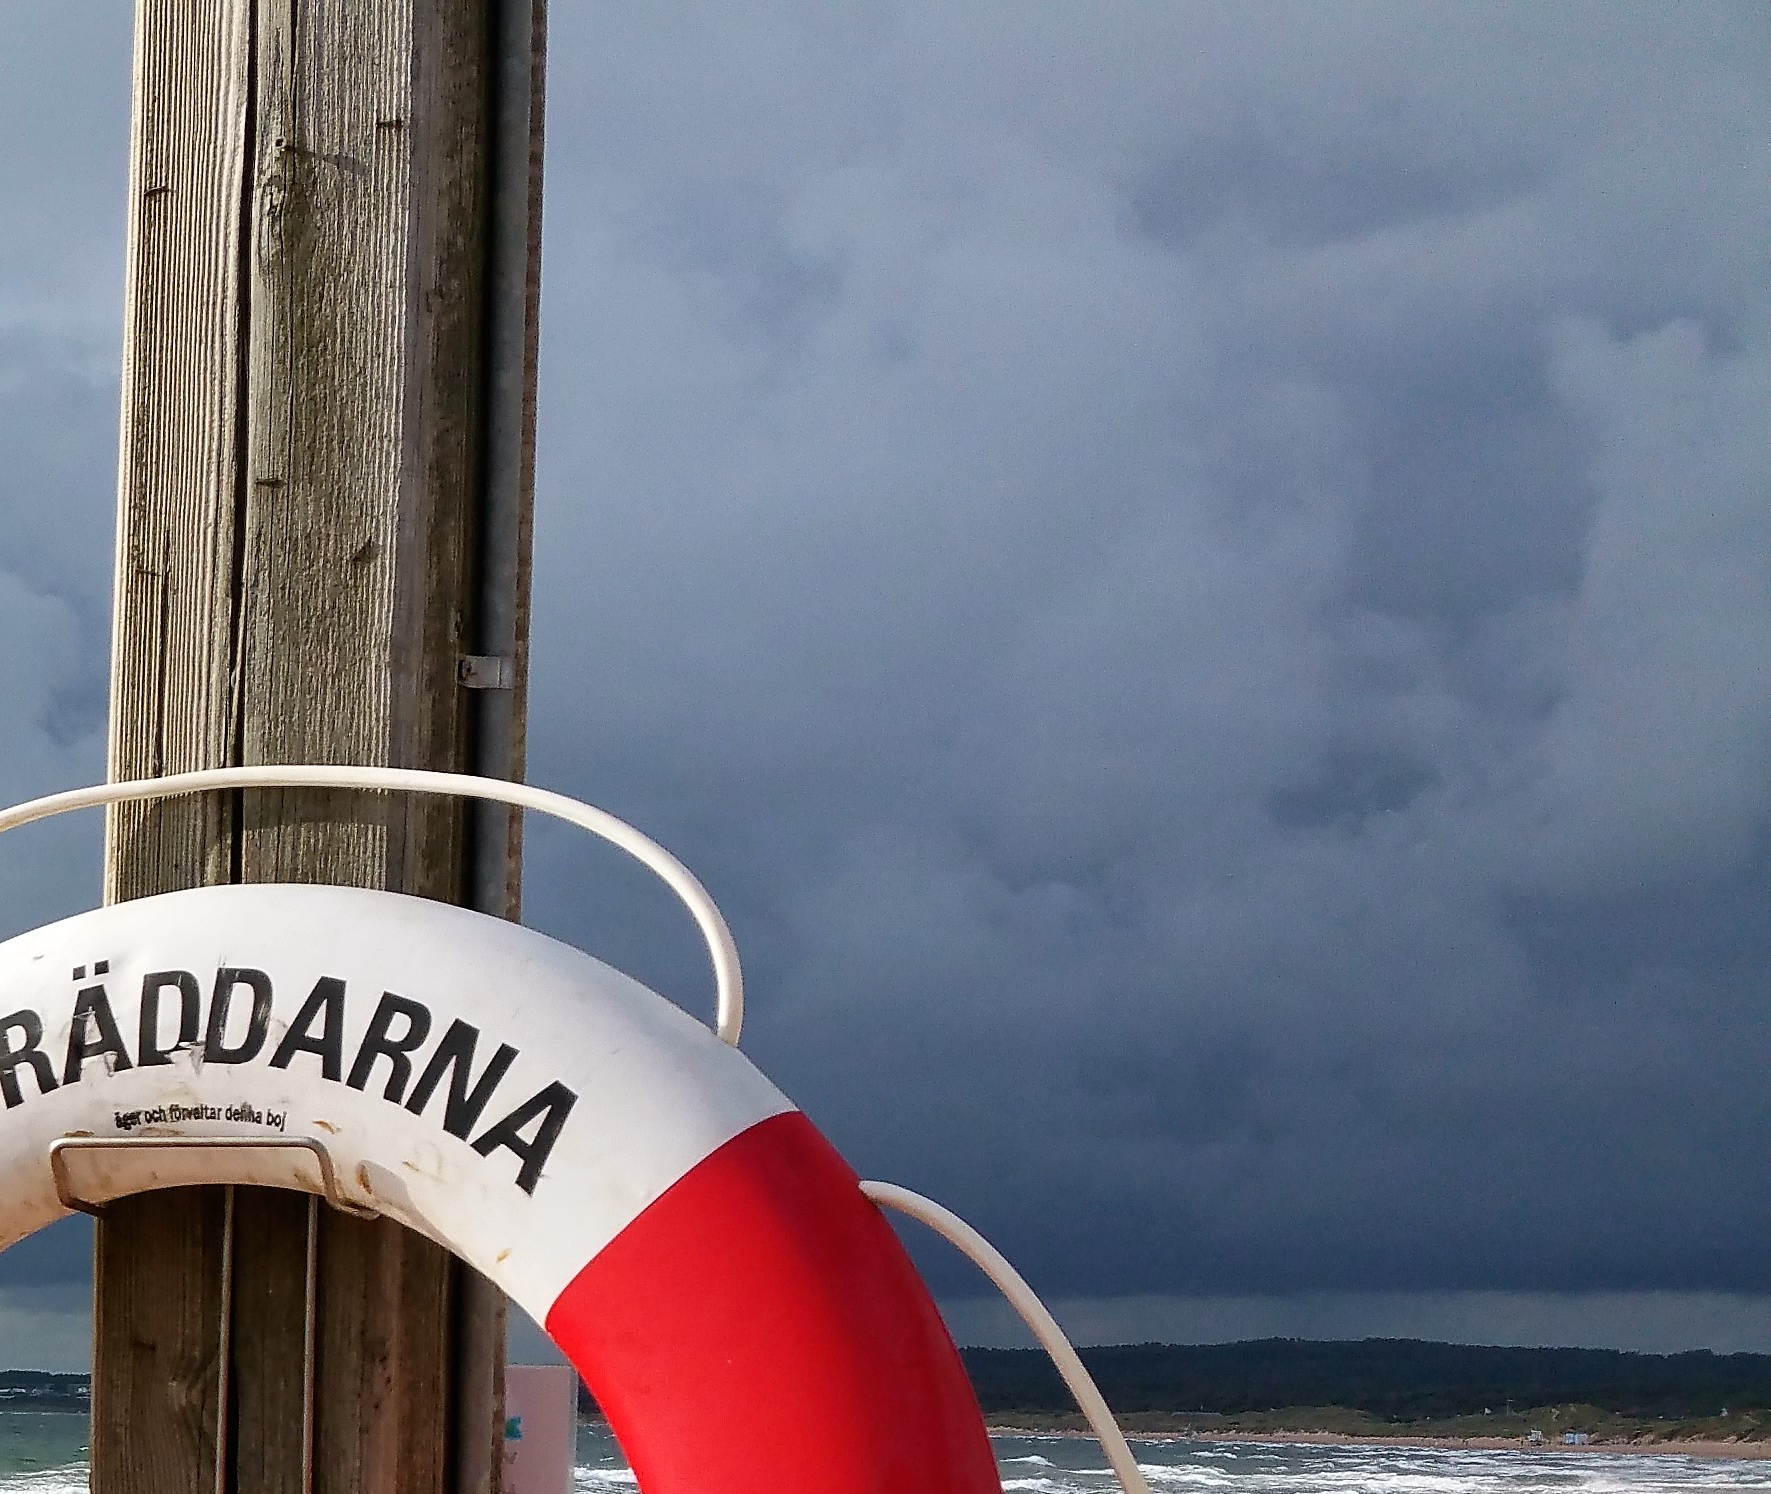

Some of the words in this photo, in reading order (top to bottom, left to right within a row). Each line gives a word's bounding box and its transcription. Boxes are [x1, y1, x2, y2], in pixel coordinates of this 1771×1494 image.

[144, 1105, 166, 1124] och
[169, 1104, 221, 1122] förvaltar
[266, 1109, 287, 1132] boj
